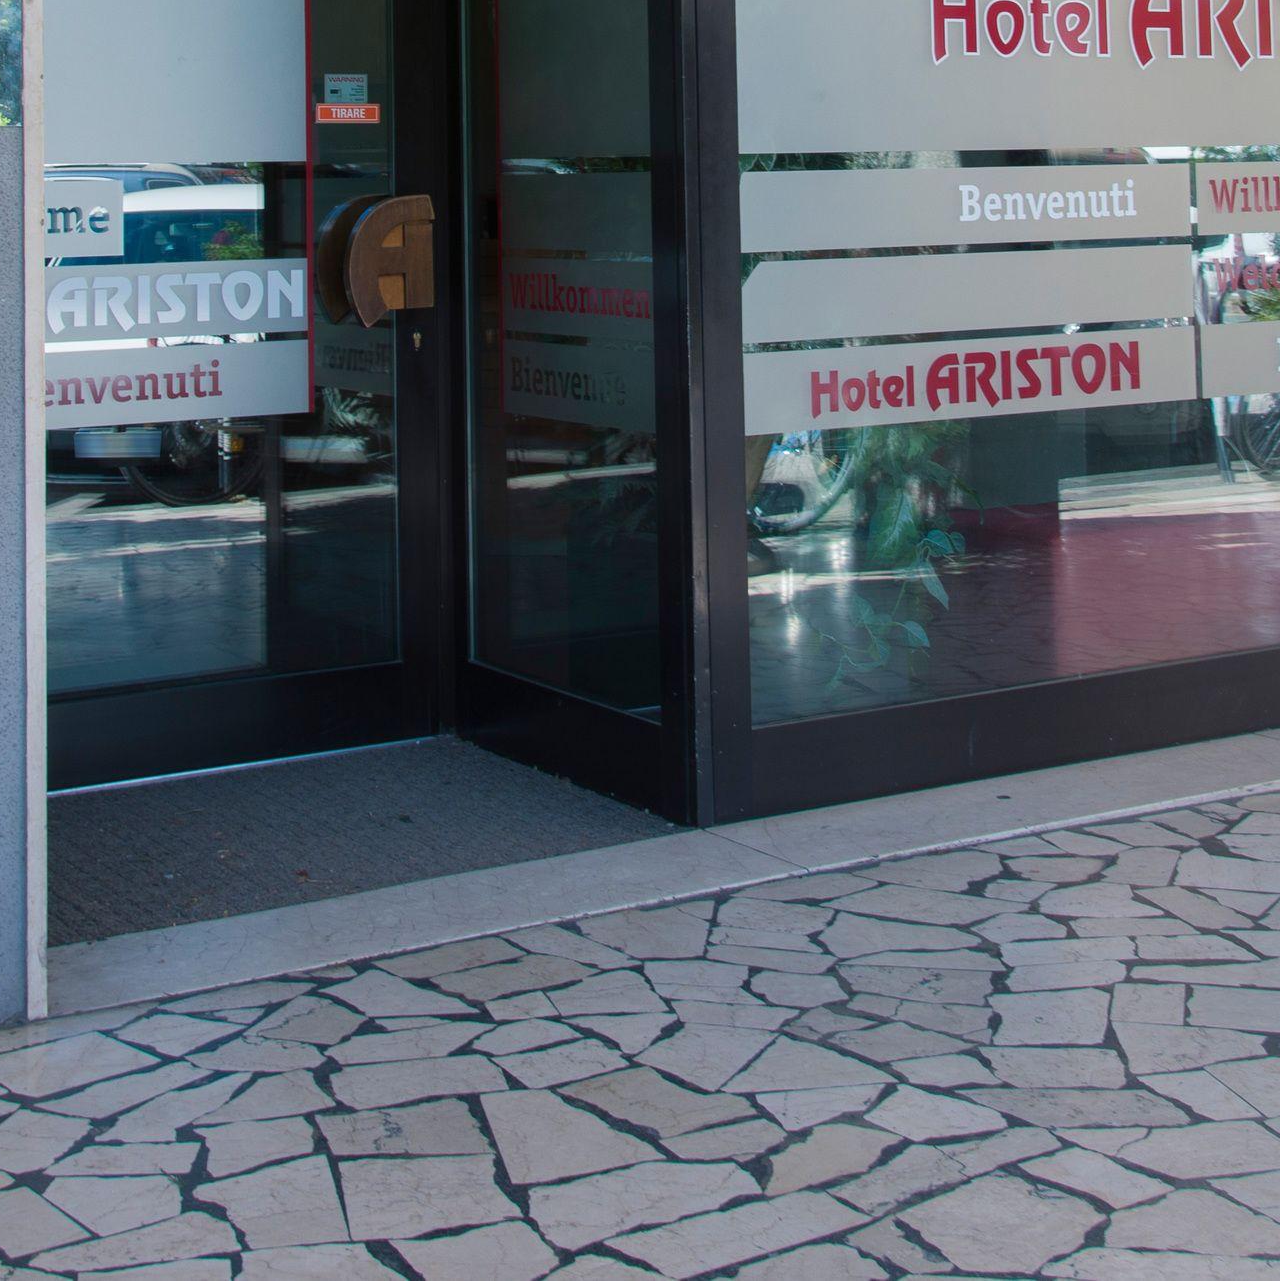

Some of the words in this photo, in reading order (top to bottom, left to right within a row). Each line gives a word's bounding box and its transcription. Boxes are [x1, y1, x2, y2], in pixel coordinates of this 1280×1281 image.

[330, 107, 366, 119] TIRARE
[958, 178, 1138, 222] Benvenuti
[47, 268, 304, 335] ARISTON
[509, 271, 652, 319] Willkommen
[510, 355, 627, 406] Bienvee
[810, 365, 915, 419] Hotel
[926, 340, 1141, 412] ARISTON
